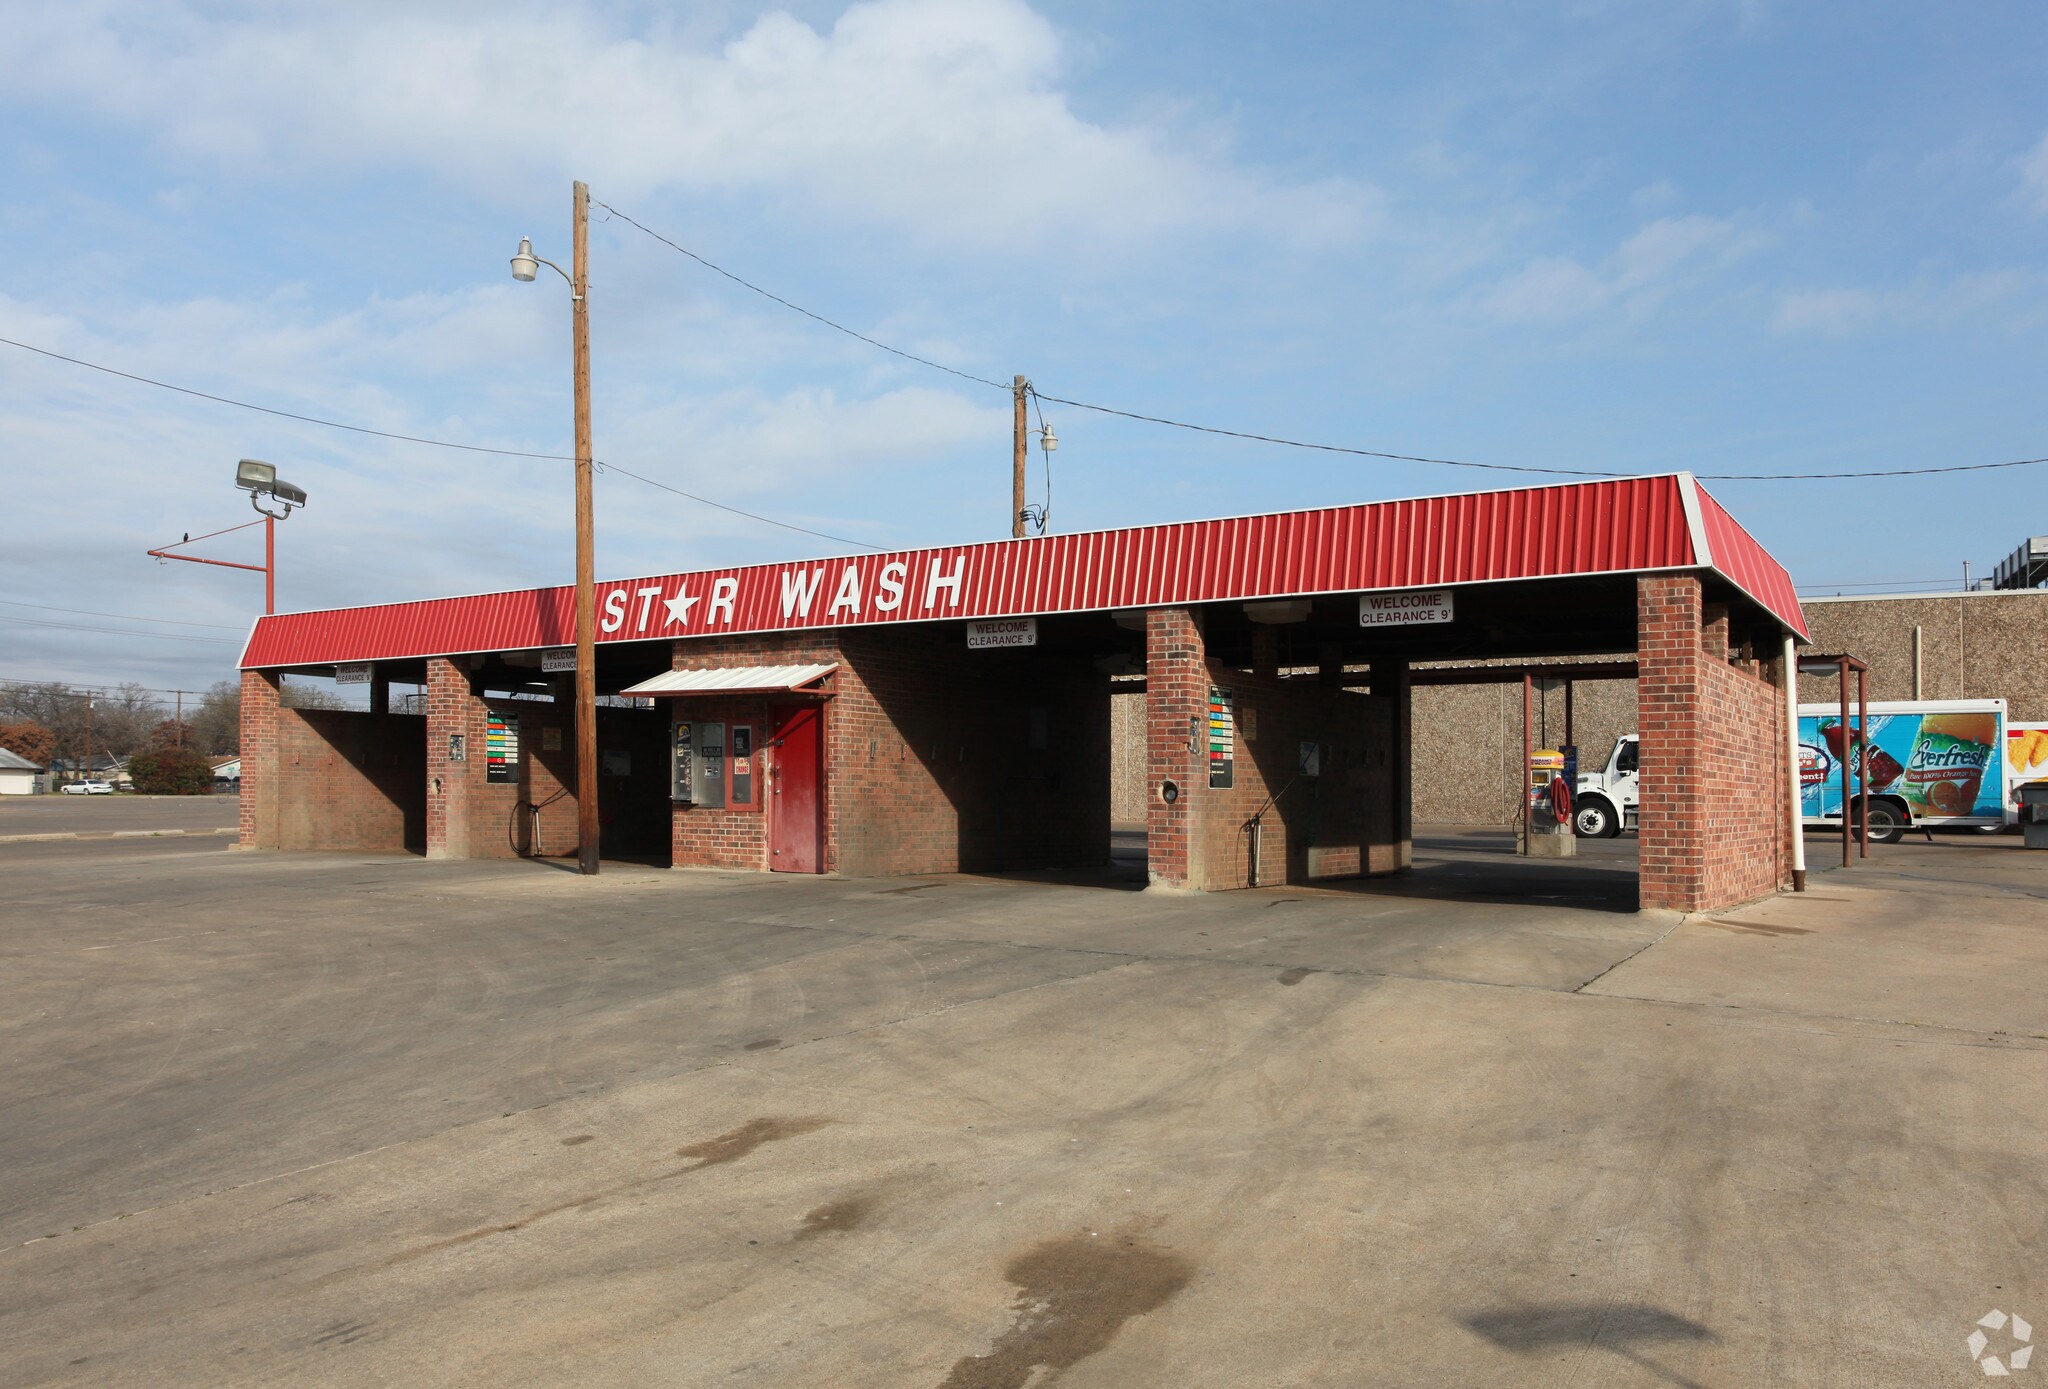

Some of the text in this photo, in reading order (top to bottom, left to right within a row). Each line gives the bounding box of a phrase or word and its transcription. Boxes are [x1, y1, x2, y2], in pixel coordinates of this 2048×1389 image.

[782, 555, 966, 619] WASH
[1370, 594, 1442, 610] WELCOME
[1361, 610, 1435, 624] CLEARANCE
[976, 621, 1029, 634] WELCOME
[969, 634, 1024, 646] CLEARANCE
[546, 650, 577, 660] WELCOM
[340, 664, 369, 674] WELCOME
[336, 674, 364, 682] CLEARANCE
[1911, 739, 1985, 769] Everfresh
